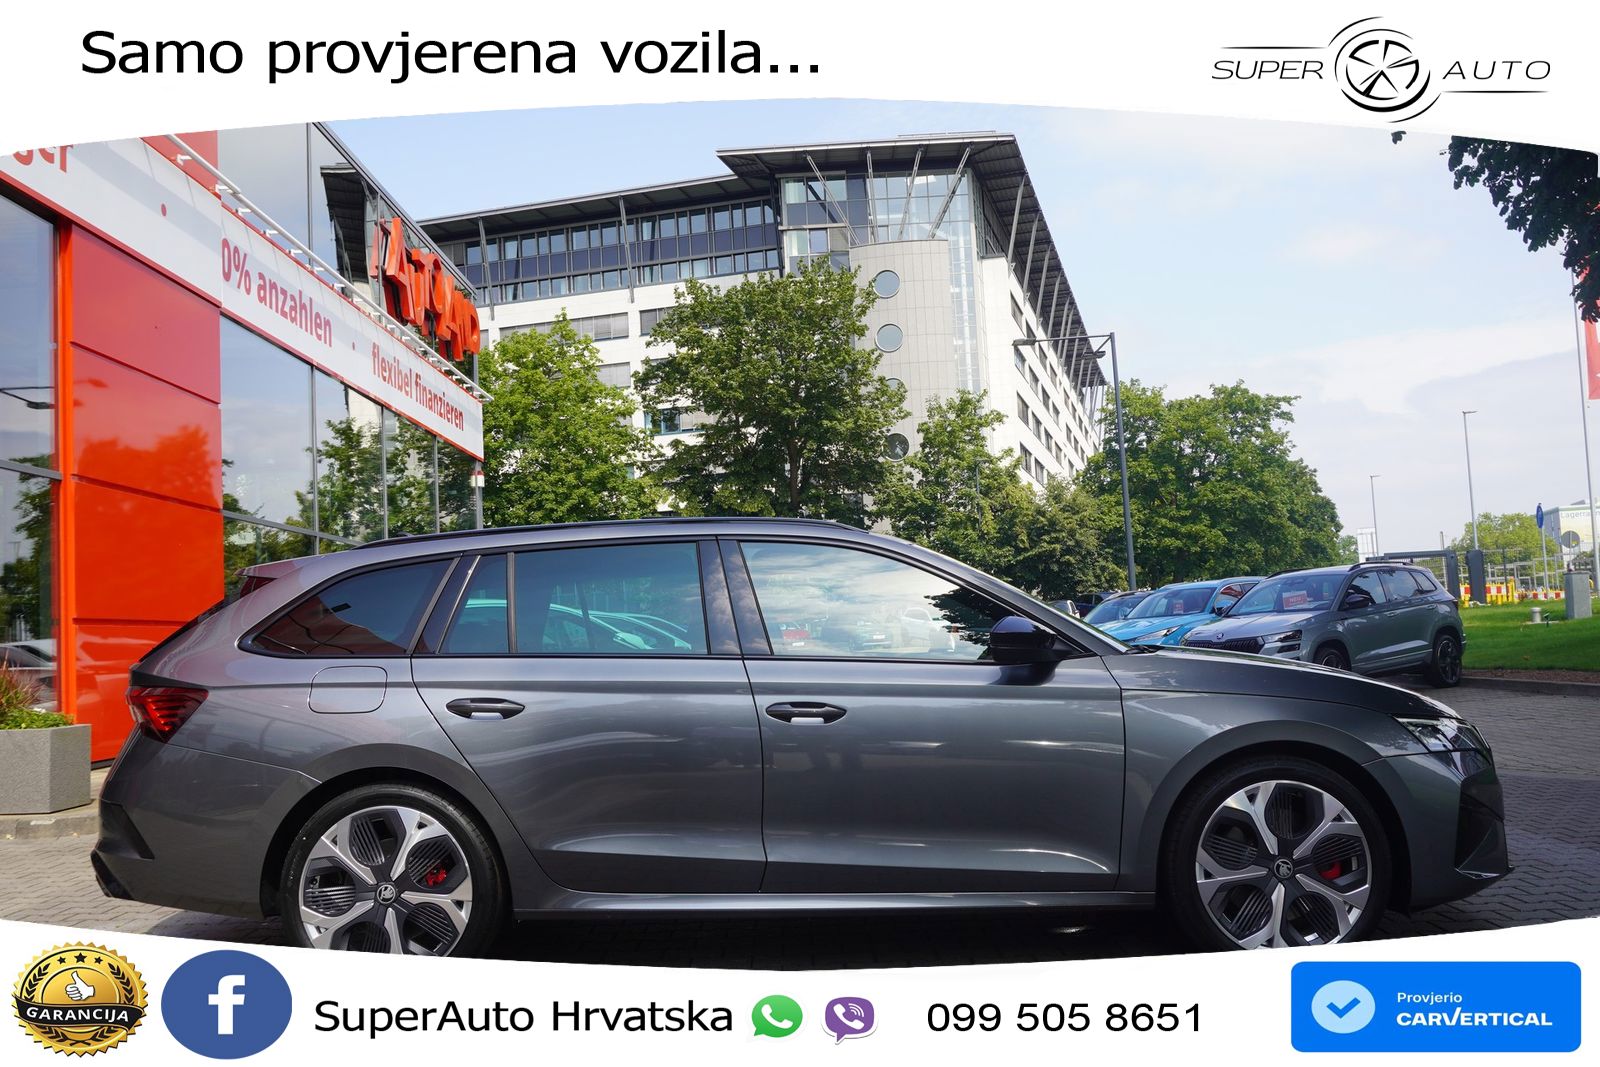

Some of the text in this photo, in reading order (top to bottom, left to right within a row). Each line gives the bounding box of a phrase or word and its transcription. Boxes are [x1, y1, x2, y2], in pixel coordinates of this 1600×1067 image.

[221, 238, 333, 348] 0% anzahlen
[371, 342, 464, 432] flexibel finanzieren
